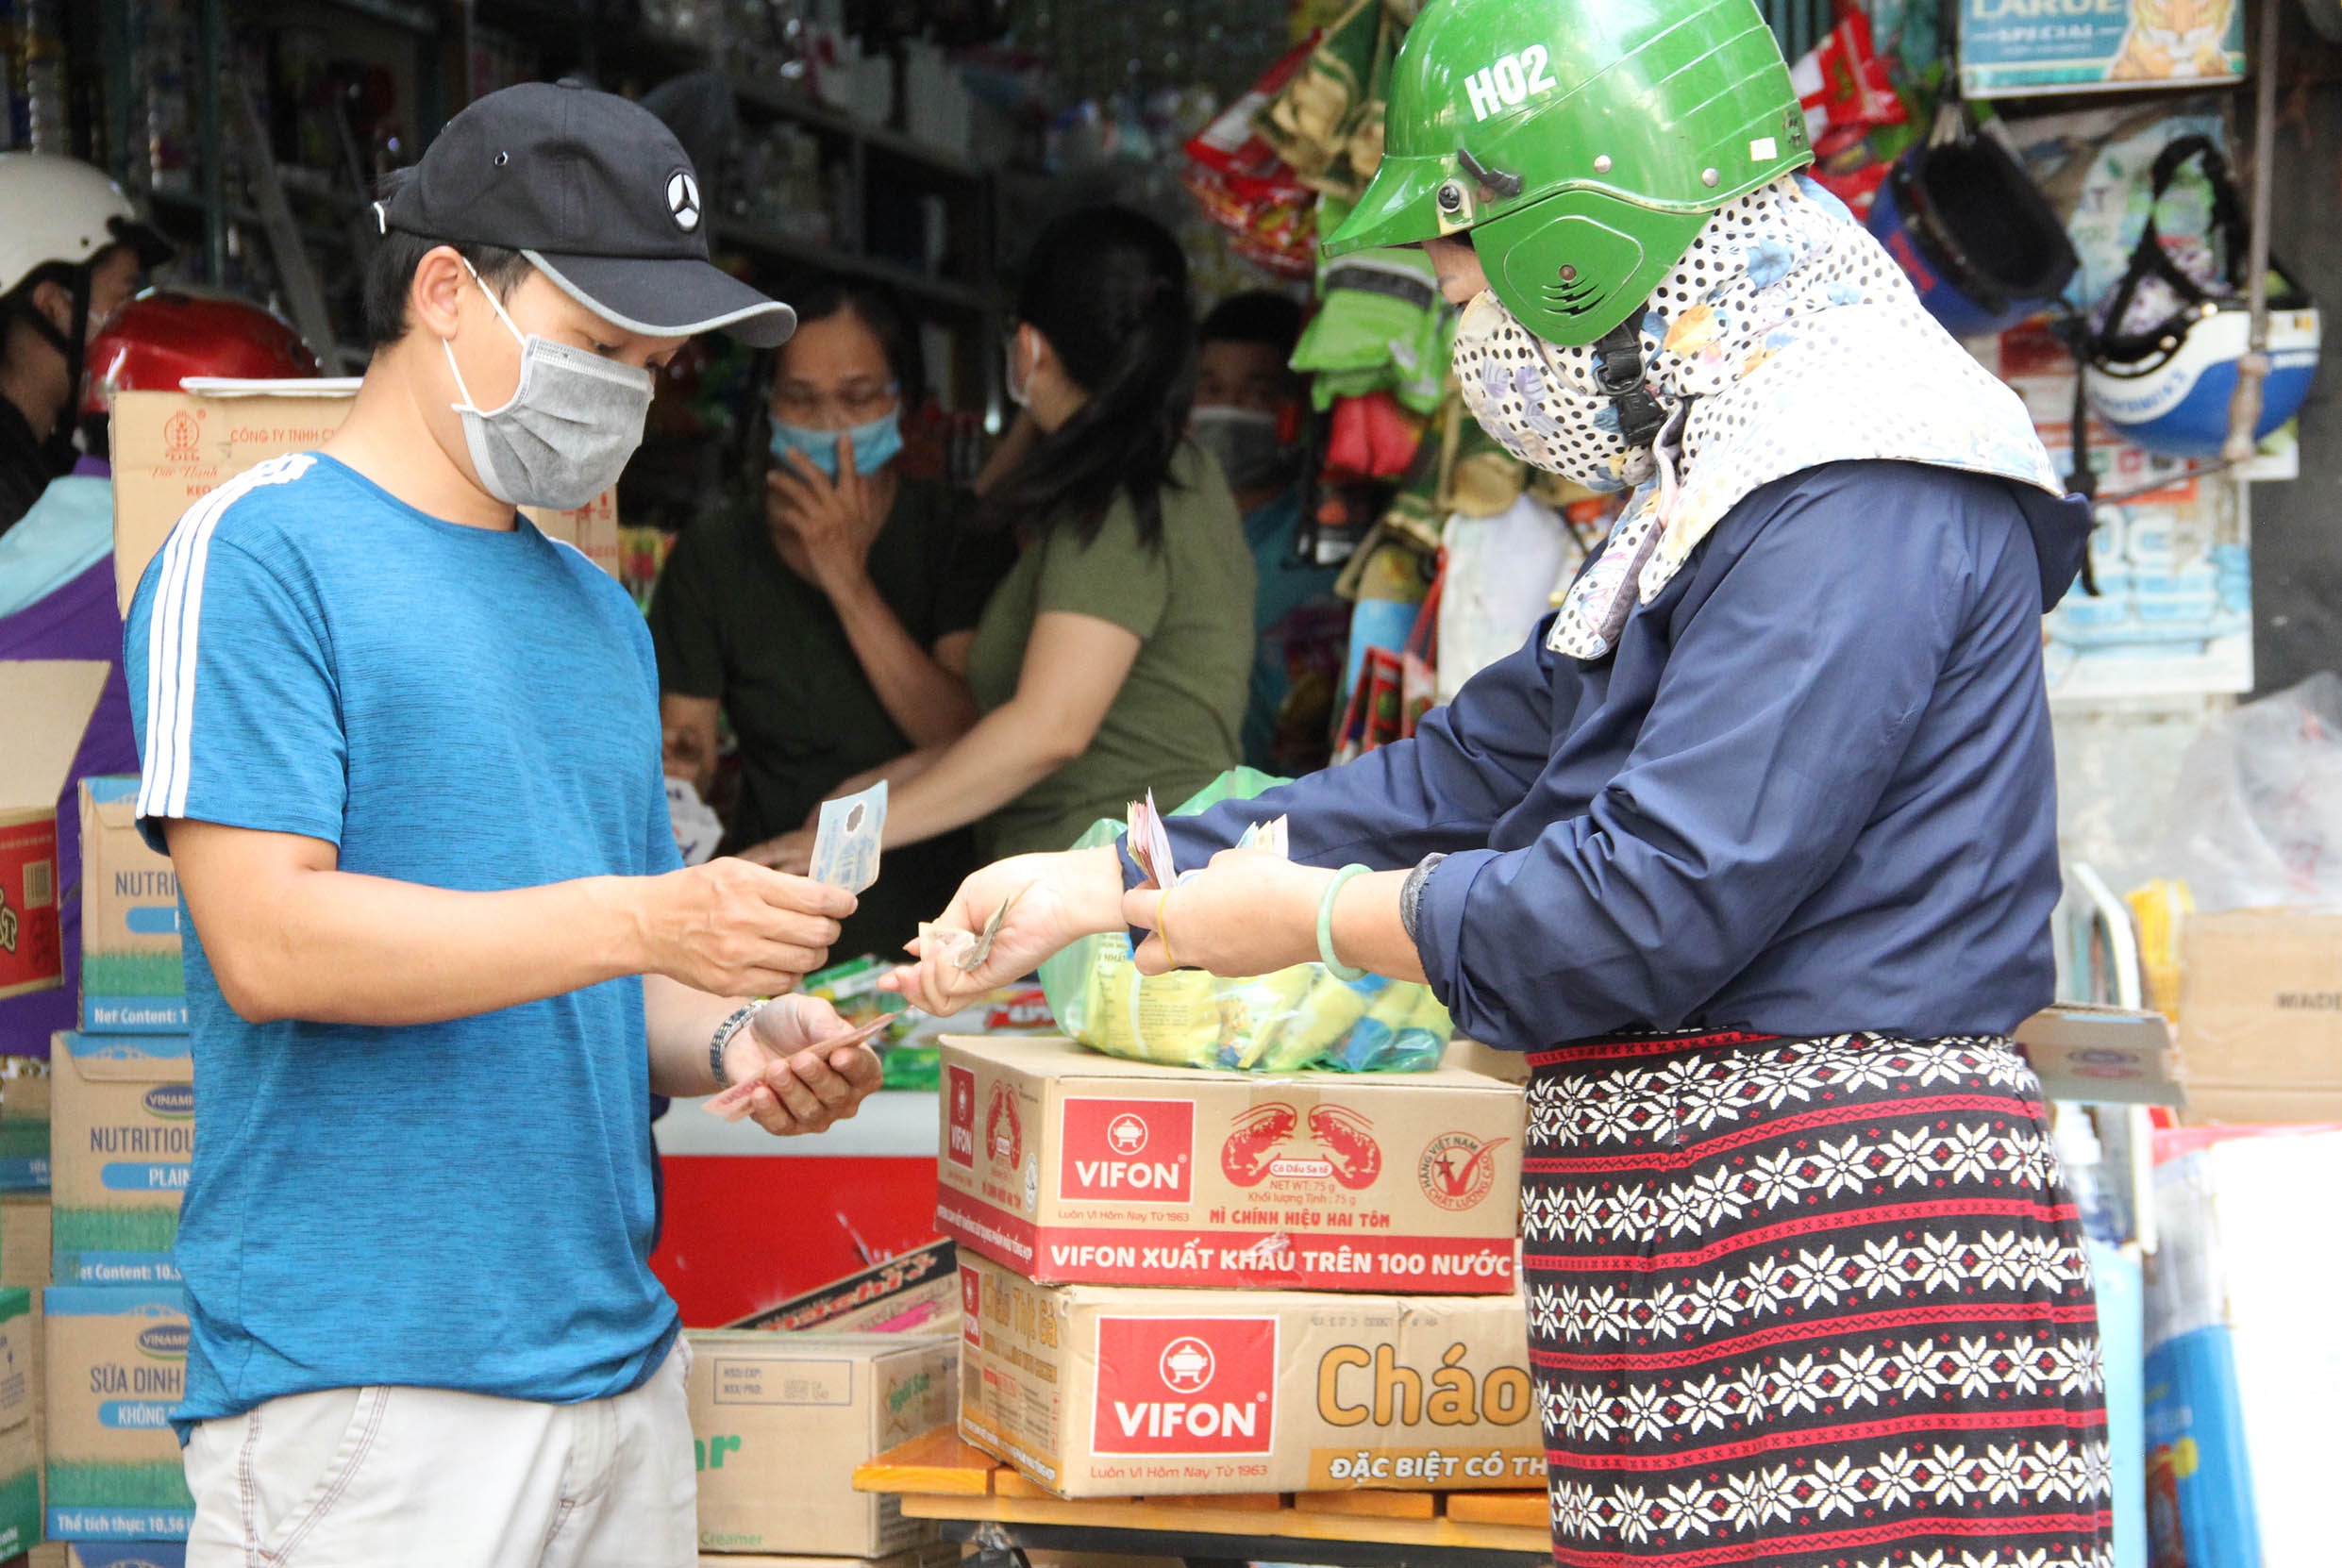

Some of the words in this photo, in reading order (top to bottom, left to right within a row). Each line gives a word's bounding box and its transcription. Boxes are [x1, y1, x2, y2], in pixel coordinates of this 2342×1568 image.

[94, 1009, 117, 1024] Net
[121, 1009, 177, 1025] Content:
[1453, 1138, 1479, 1150] NAM
[1075, 1160, 1179, 1190] VIFON
[1270, 1180, 1290, 1191] NET
[1314, 1181, 1327, 1192] 75
[1058, 1209, 1084, 1220] Luôn
[1100, 1209, 1124, 1221] Hôm
[1127, 1210, 1147, 1224] Nay
[1166, 1212, 1190, 1223] 1963
[1210, 1206, 1226, 1224] MÌ
[1231, 1207, 1279, 1226] CHÍNH
[1284, 1209, 1321, 1228] HIỆU
[1328, 1212, 1352, 1226] HAI
[1359, 1210, 1391, 1227] TÔM
[1050, 1244, 1135, 1268] VIFON
[1142, 1237, 1213, 1270] XUẤT
[1302, 1244, 1371, 1274] TRÊN
[1378, 1254, 1426, 1275] 100
[1431, 1249, 1511, 1277] NƯỚC
[95, 1264, 151, 1280] Content:
[90, 1363, 127, 1393] SỮA
[134, 1368, 180, 1393] DINH
[1316, 1342, 1532, 1427] Cháo
[118, 1402, 165, 1426] KHÔNG
[1113, 1401, 1256, 1438] VIFON
[1091, 1465, 1125, 1479] Luôn
[1146, 1465, 1179, 1479] Hôm
[1183, 1466, 1211, 1480] Nay
[1238, 1464, 1268, 1477] 1963
[1330, 1451, 1389, 1484] ĐẶC
[1395, 1449, 1460, 1483] BIỆT
[1464, 1451, 1505, 1477] CÓ
